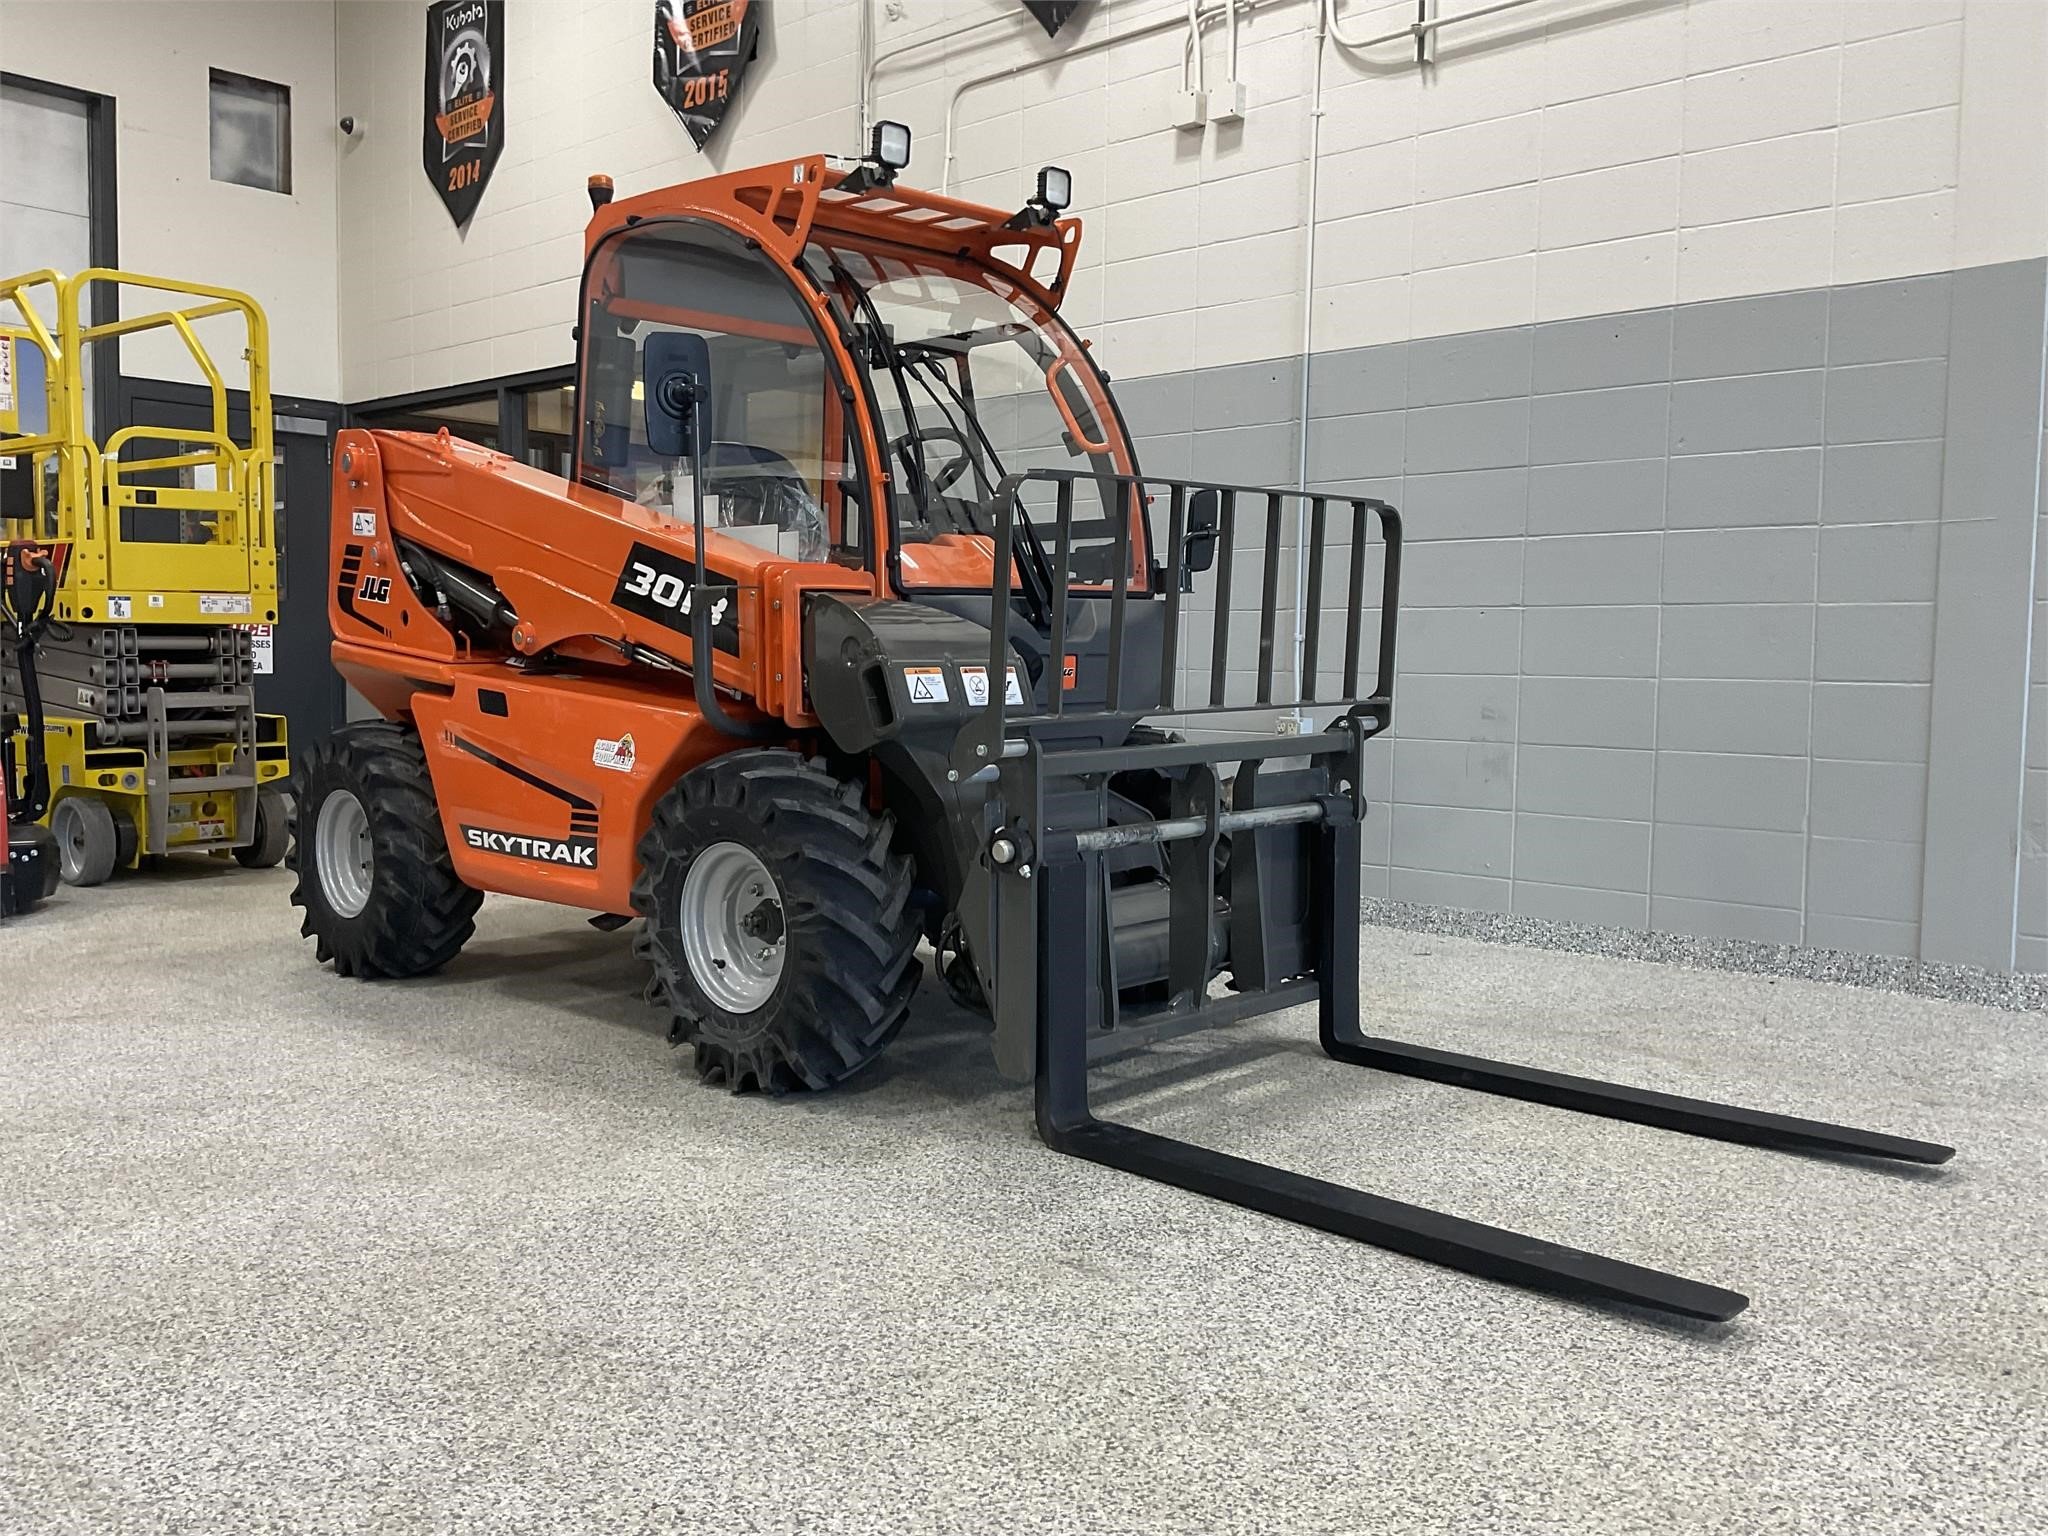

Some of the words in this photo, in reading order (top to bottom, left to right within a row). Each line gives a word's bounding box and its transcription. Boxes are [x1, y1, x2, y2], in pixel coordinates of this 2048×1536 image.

[446, 4, 484, 31] Kubota
[690, 5, 732, 33] SERVICE
[684, 21, 736, 50] ERTIFIED
[684, 68, 729, 109] 2015
[448, 118, 482, 141] CERTIFIED
[450, 104, 479, 127] SERVICE
[448, 159, 481, 191] 2014
[358, 574, 393, 605] JLG
[1063, 667, 1075, 677] LG
[467, 829, 595, 866] SKYTRAK
